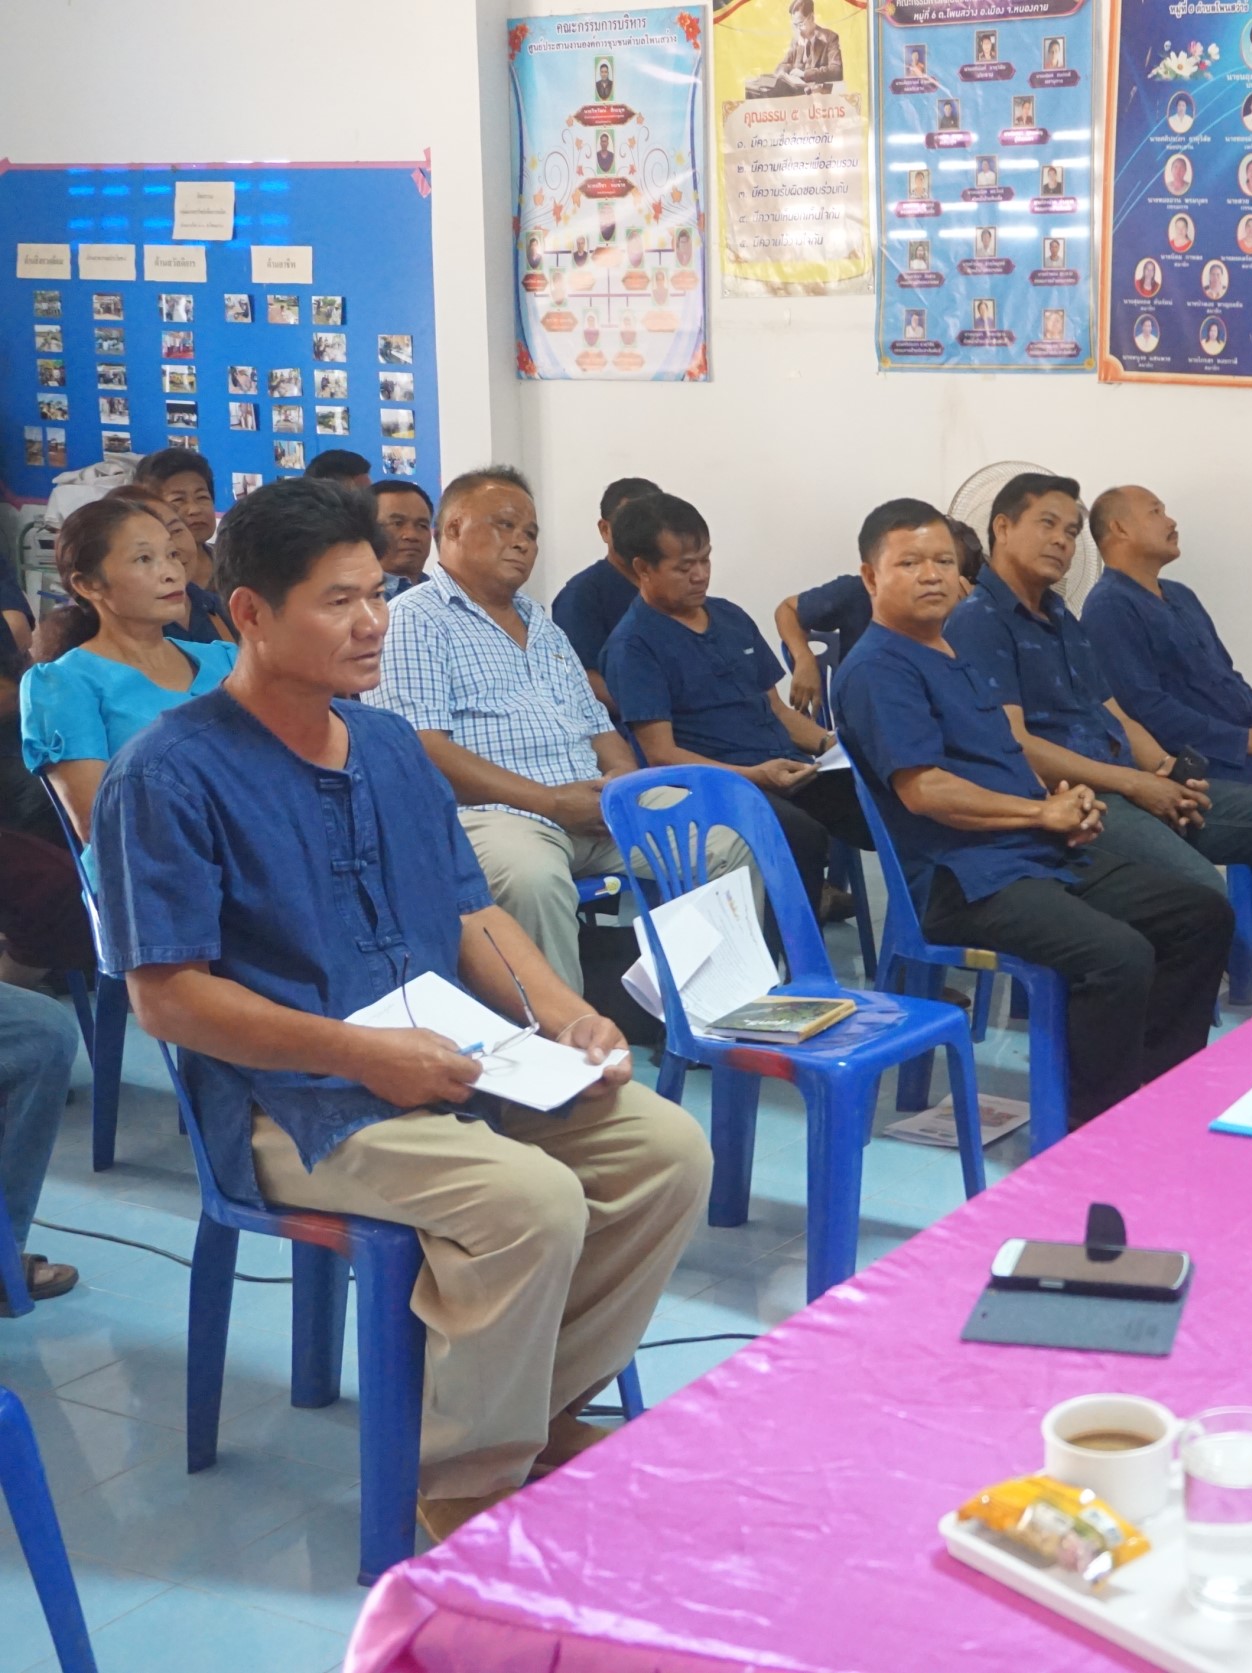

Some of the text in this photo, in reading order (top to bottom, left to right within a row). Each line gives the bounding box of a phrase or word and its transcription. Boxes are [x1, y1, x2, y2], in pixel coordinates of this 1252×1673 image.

[556, 14, 647, 34] คณะกรรมการบริหาร
[744, 110, 786, 128] คุณธรรม
[808, 104, 846, 120] ประการ
